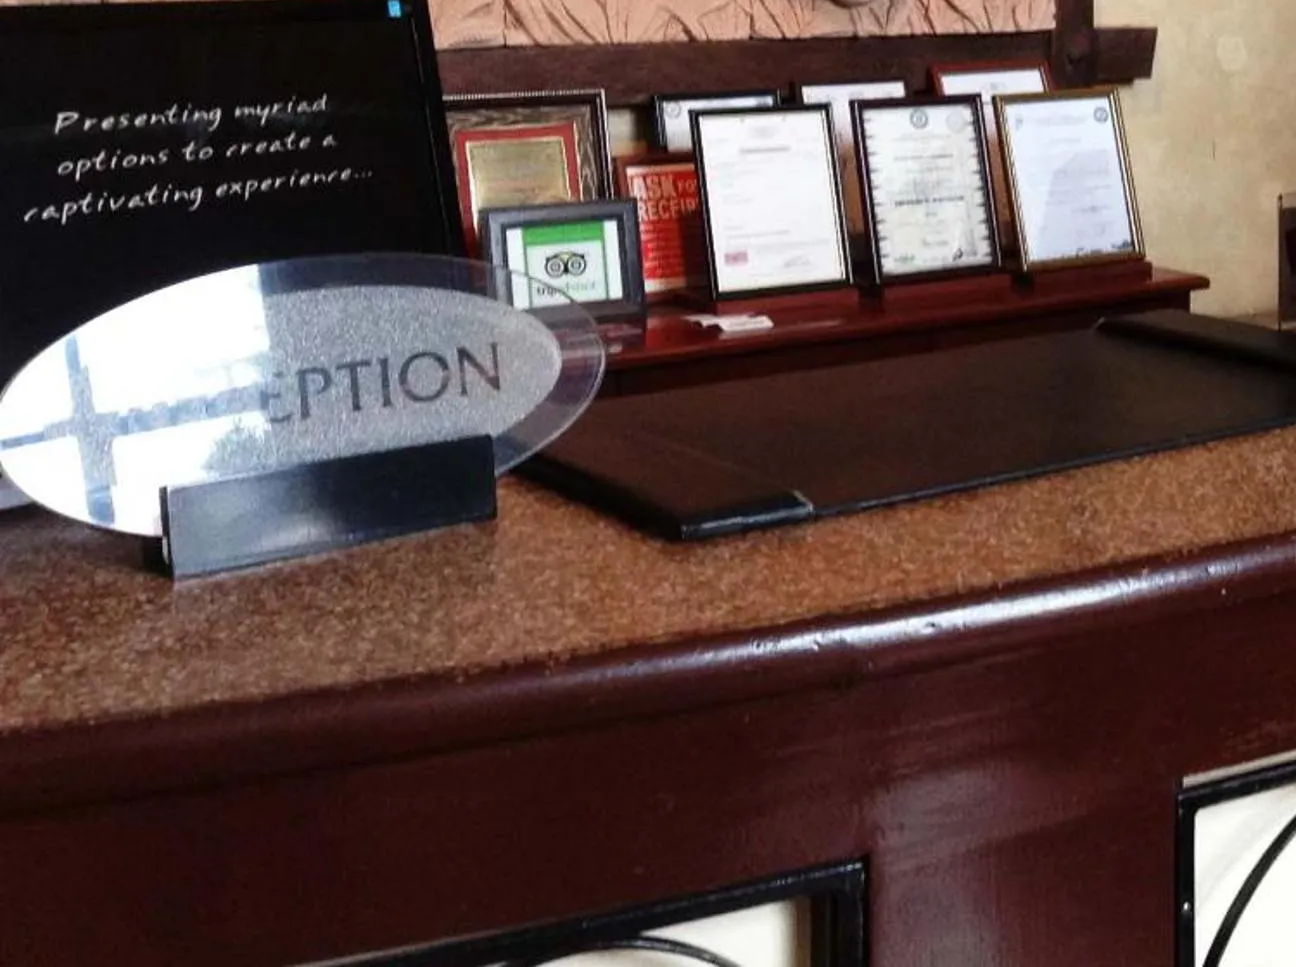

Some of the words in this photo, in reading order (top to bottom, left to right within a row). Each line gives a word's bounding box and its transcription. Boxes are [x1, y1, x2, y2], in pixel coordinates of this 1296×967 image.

[54, 103, 223, 136] Presenting
[234, 93, 328, 128] myriad
[57, 149, 169, 181] options
[182, 140, 214, 162] to
[226, 131, 312, 159] create
[321, 133, 339, 148] a
[22, 182, 204, 226] captivating
[632, 174, 676, 200] ASK
[677, 178, 698, 194] FO
[637, 196, 699, 223] RECEIP
